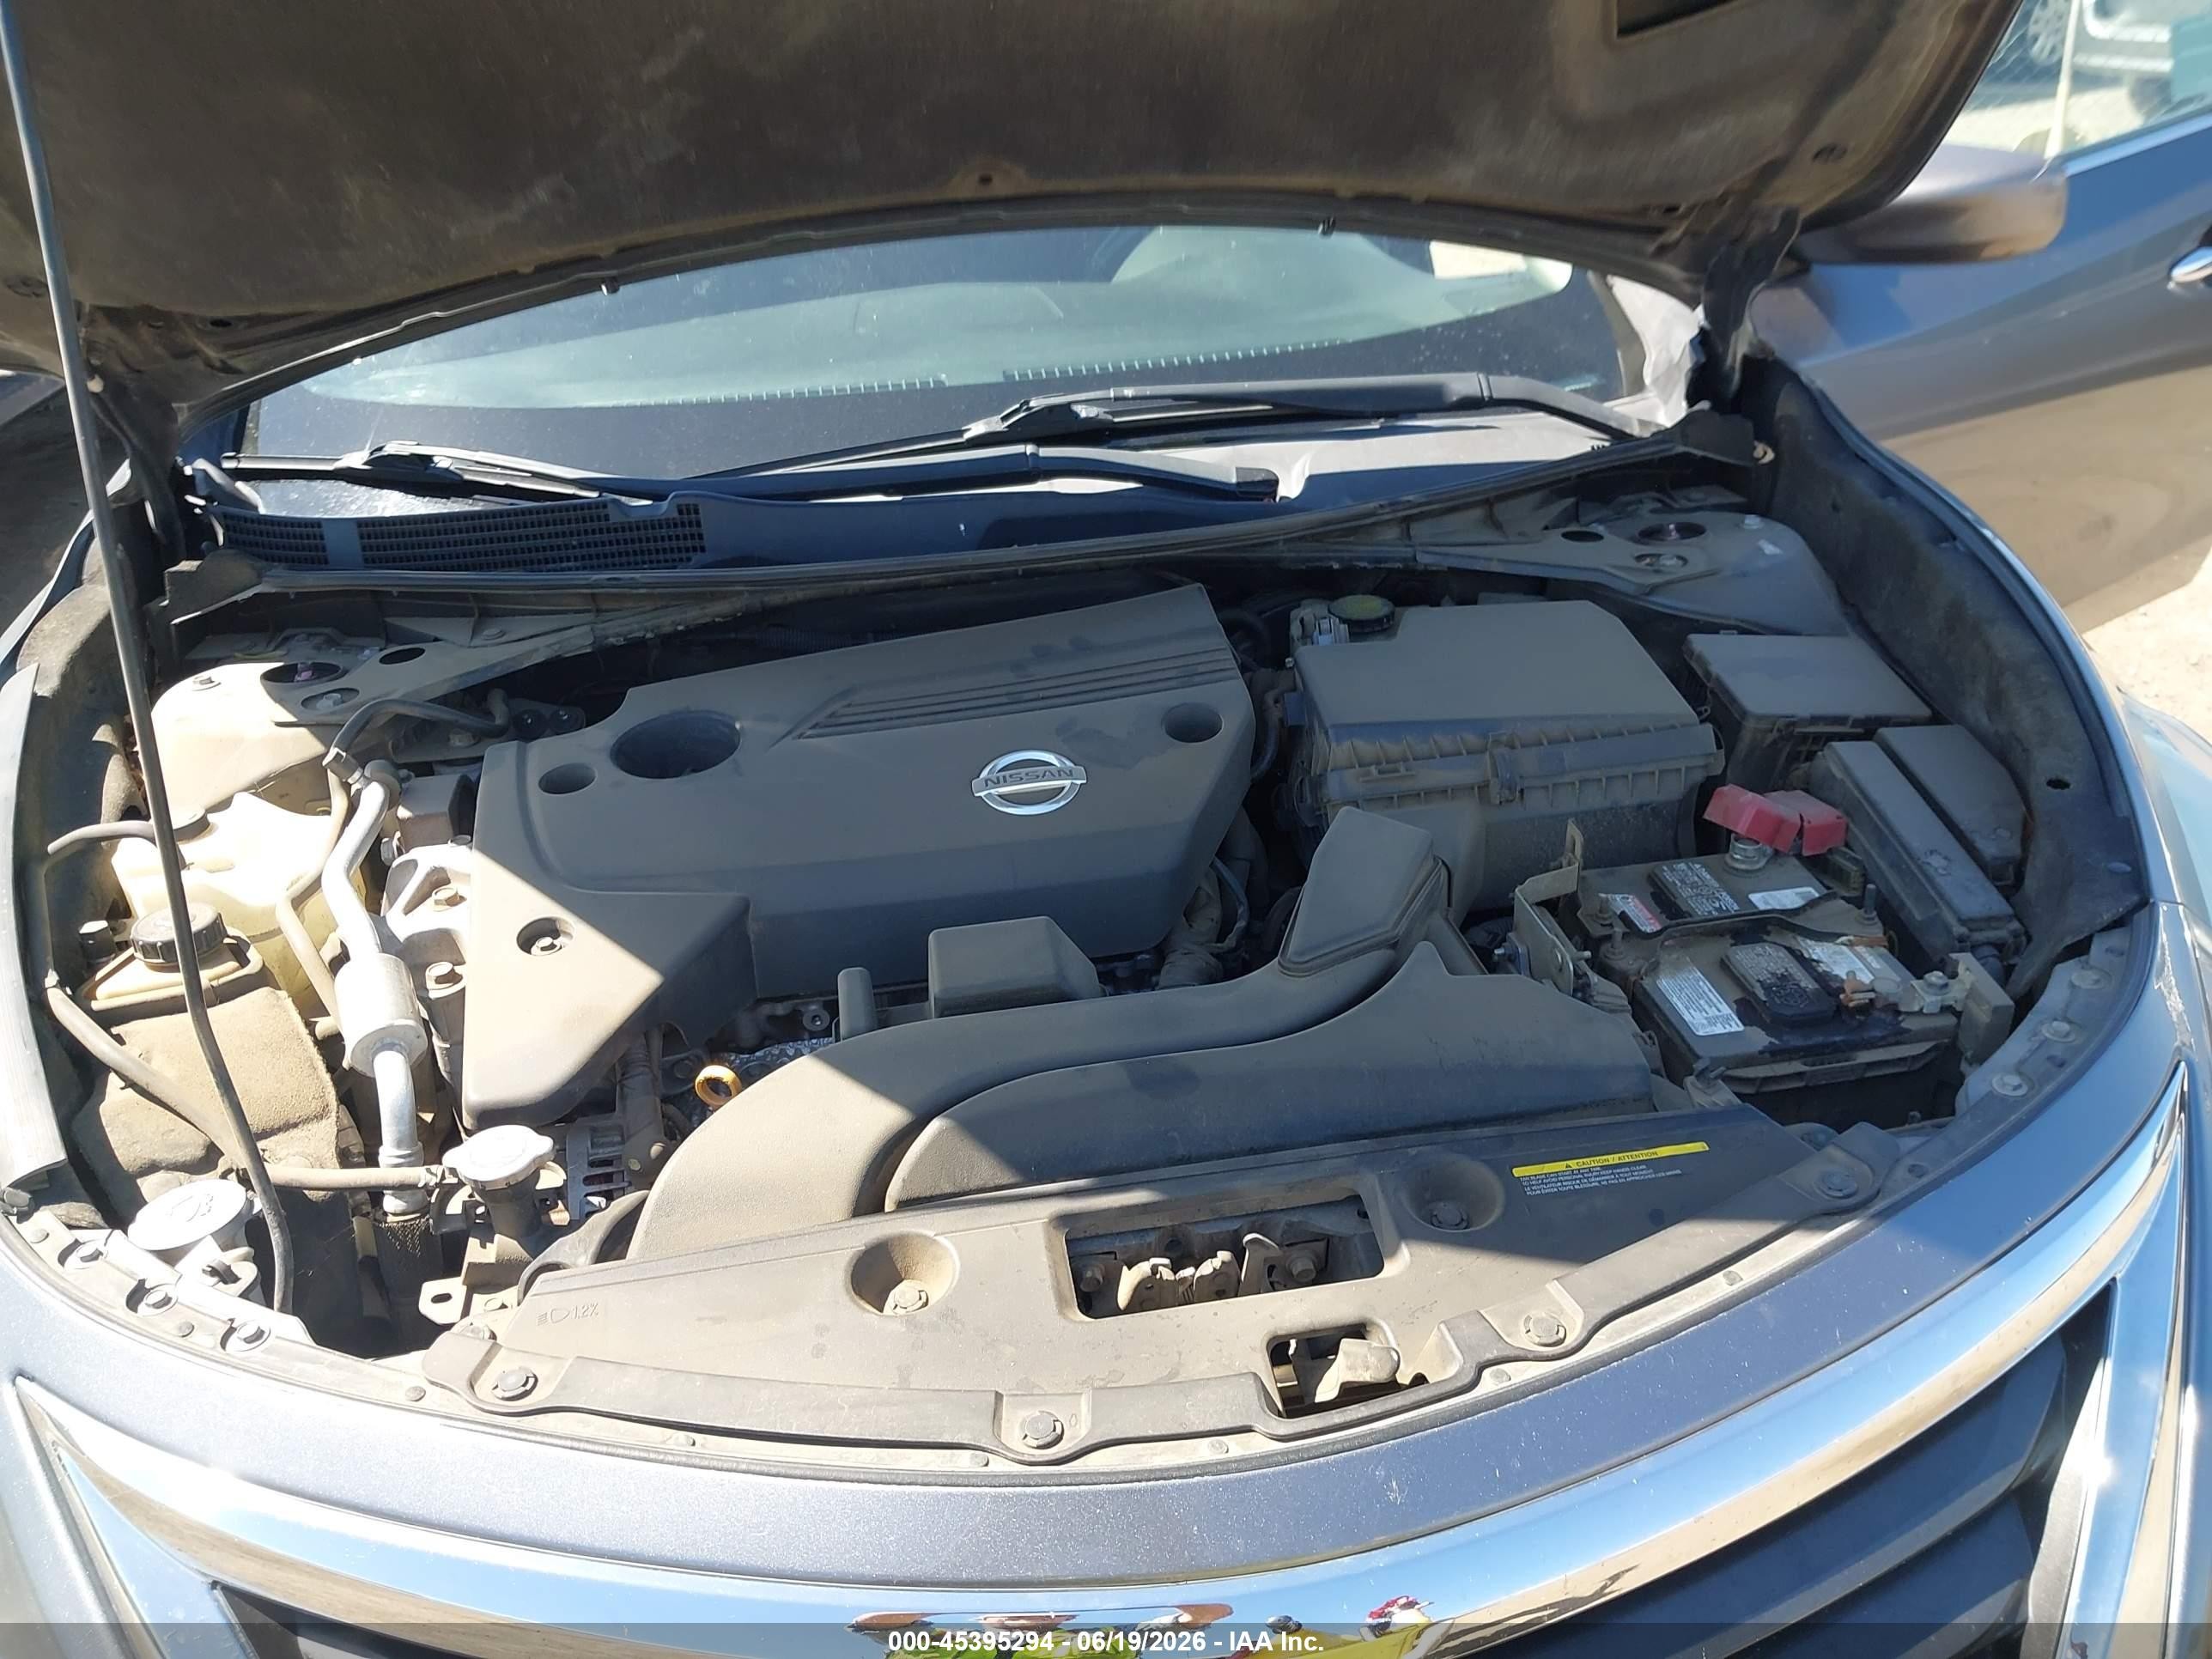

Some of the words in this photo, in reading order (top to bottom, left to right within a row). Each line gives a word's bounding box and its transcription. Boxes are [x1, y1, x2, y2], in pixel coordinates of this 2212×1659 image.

[984, 768, 1073, 787] NISSAN
[1576, 1158, 1610, 1167] CAUTION
[1617, 1151, 1658, 1161] ATTENTION
